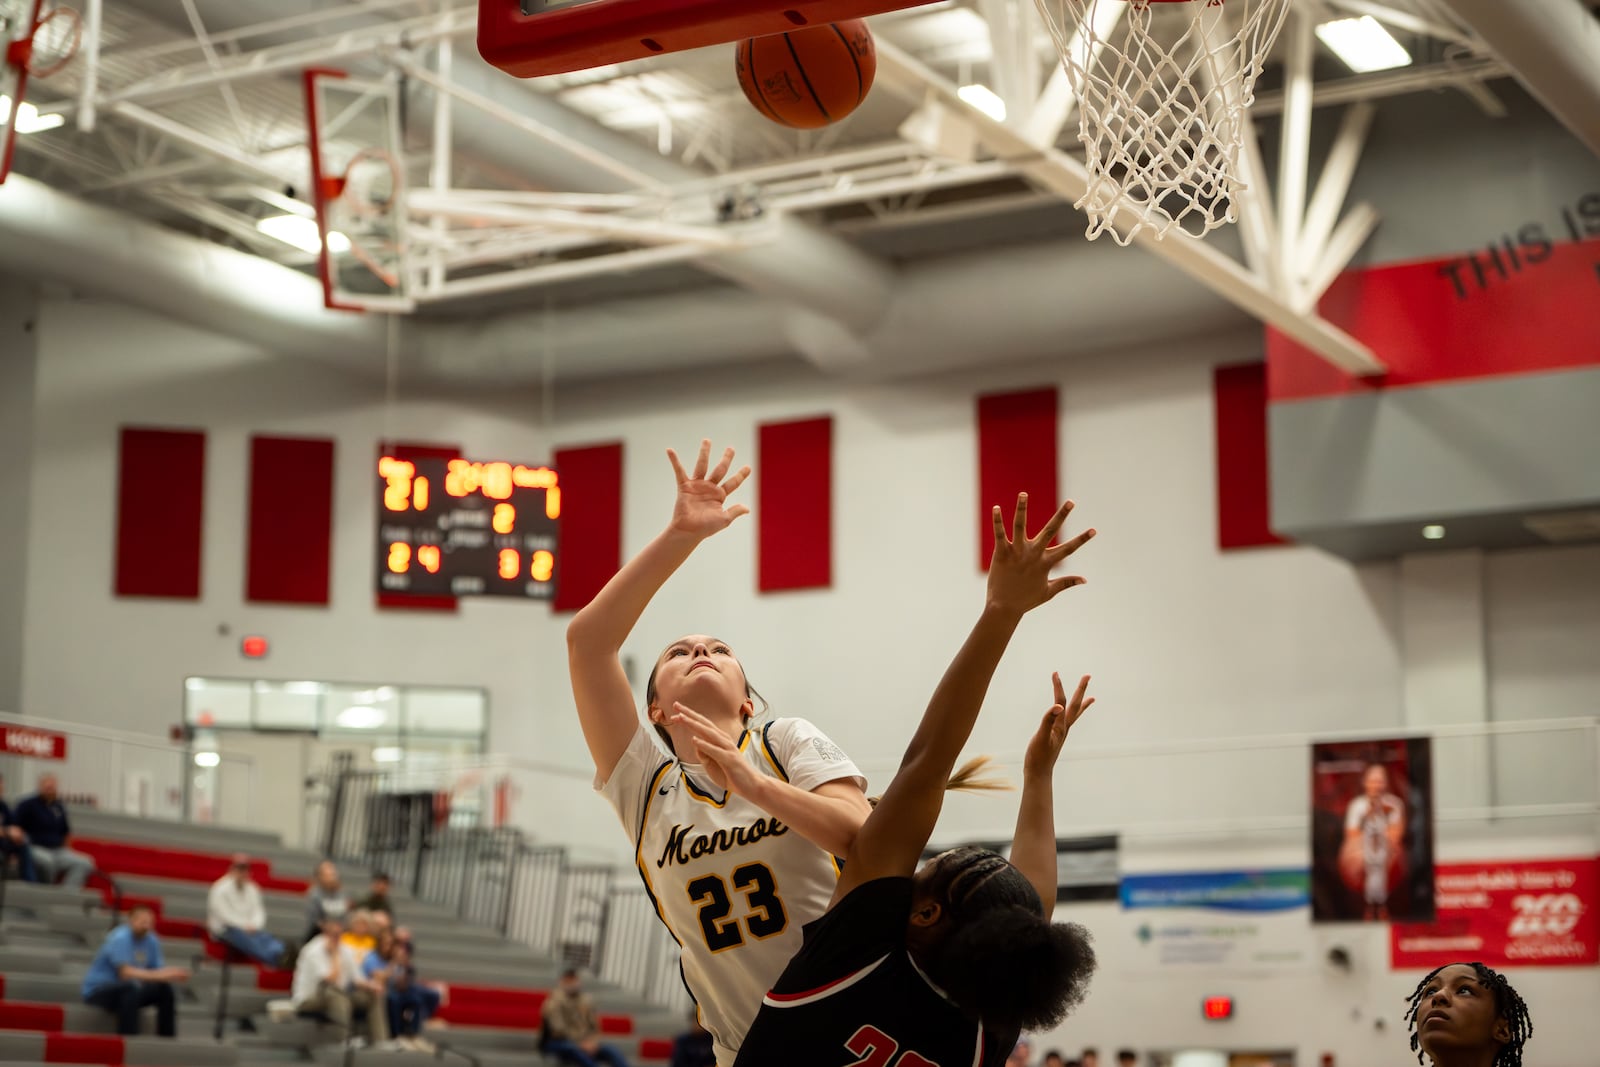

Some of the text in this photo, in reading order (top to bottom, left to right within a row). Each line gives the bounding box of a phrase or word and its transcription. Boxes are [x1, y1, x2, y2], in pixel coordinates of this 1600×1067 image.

[1438, 222, 1553, 300] THIS
[6, 731, 55, 756] HOME
[657, 817, 789, 869] Monroe
[685, 860, 789, 955] 23
[843, 1024, 941, 1067] 2
